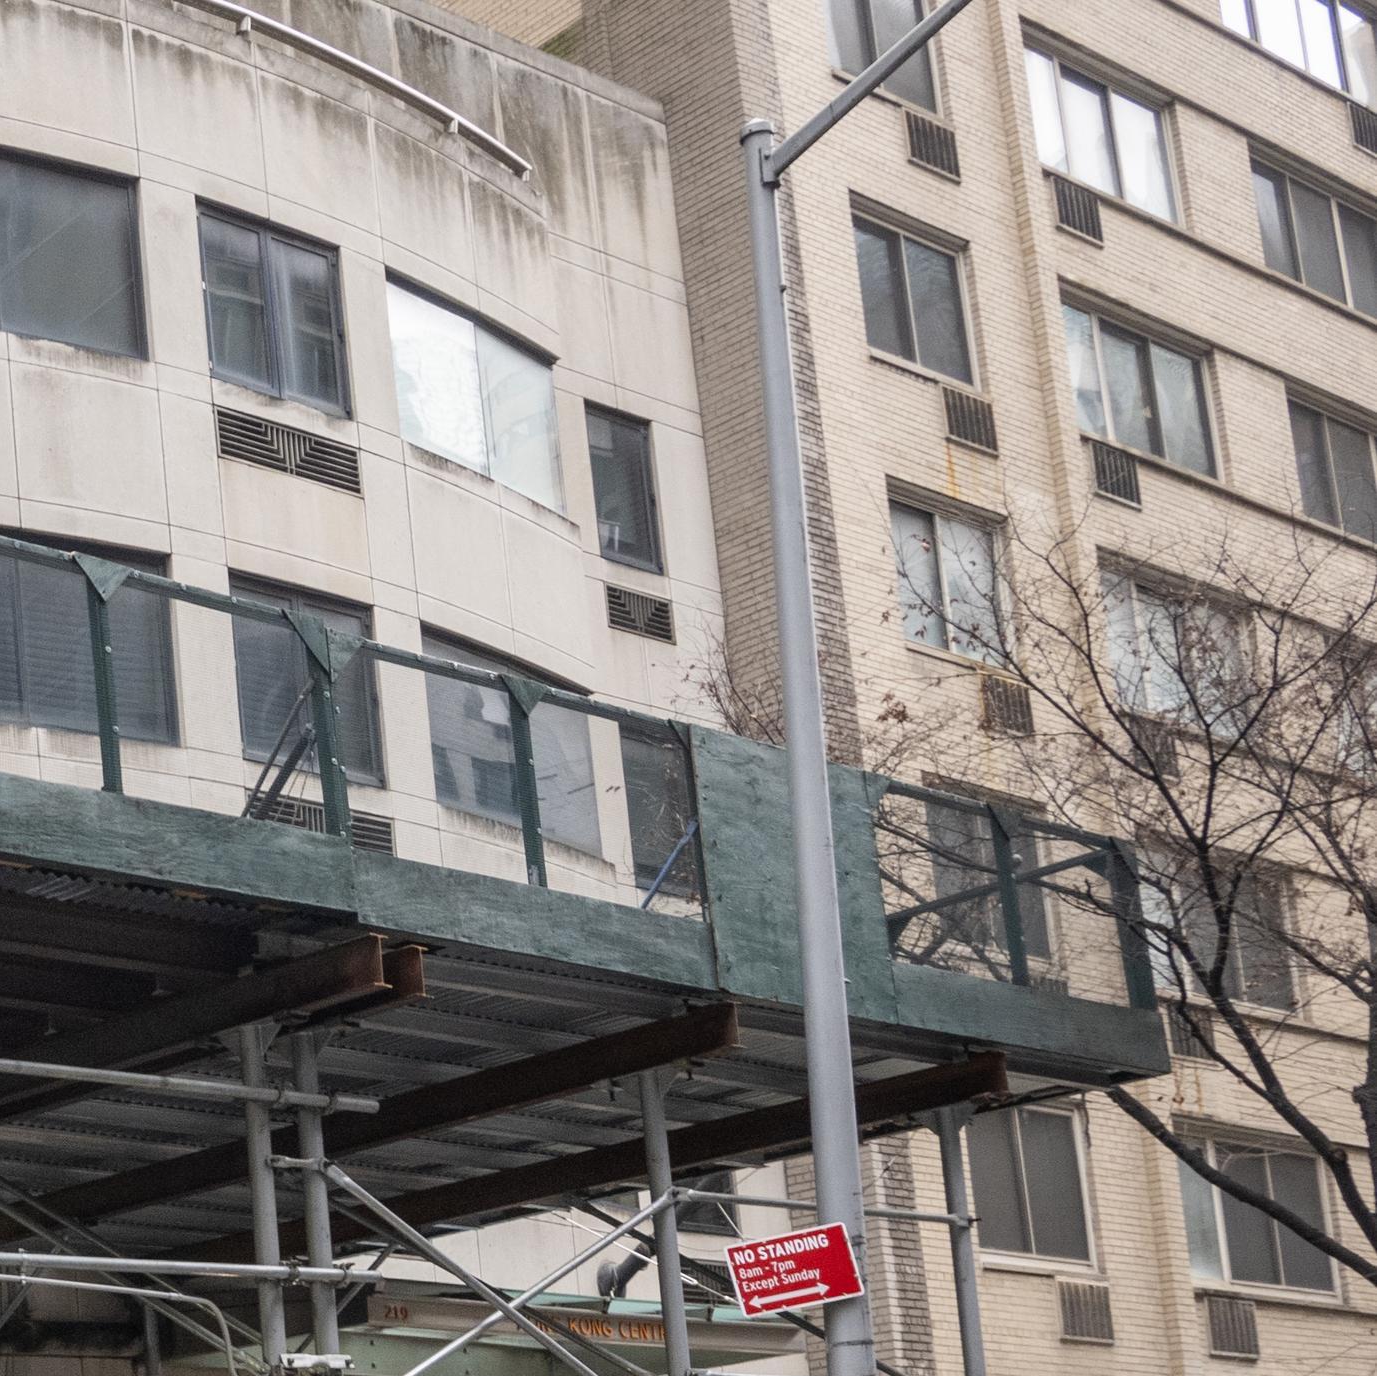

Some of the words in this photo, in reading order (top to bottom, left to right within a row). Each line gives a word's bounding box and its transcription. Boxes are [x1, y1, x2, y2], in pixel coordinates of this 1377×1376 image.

[733, 1249, 755, 1265] NO
[757, 1234, 829, 1260] STANDING
[738, 1266, 763, 1279] 8am
[771, 1260, 796, 1273] 7pm
[742, 1276, 779, 1293] Except
[781, 1268, 820, 1284] Sunday
[384, 1304, 409, 1321] 219
[567, 1317, 613, 1339] KONG
[618, 1322, 667, 1342] CENT
